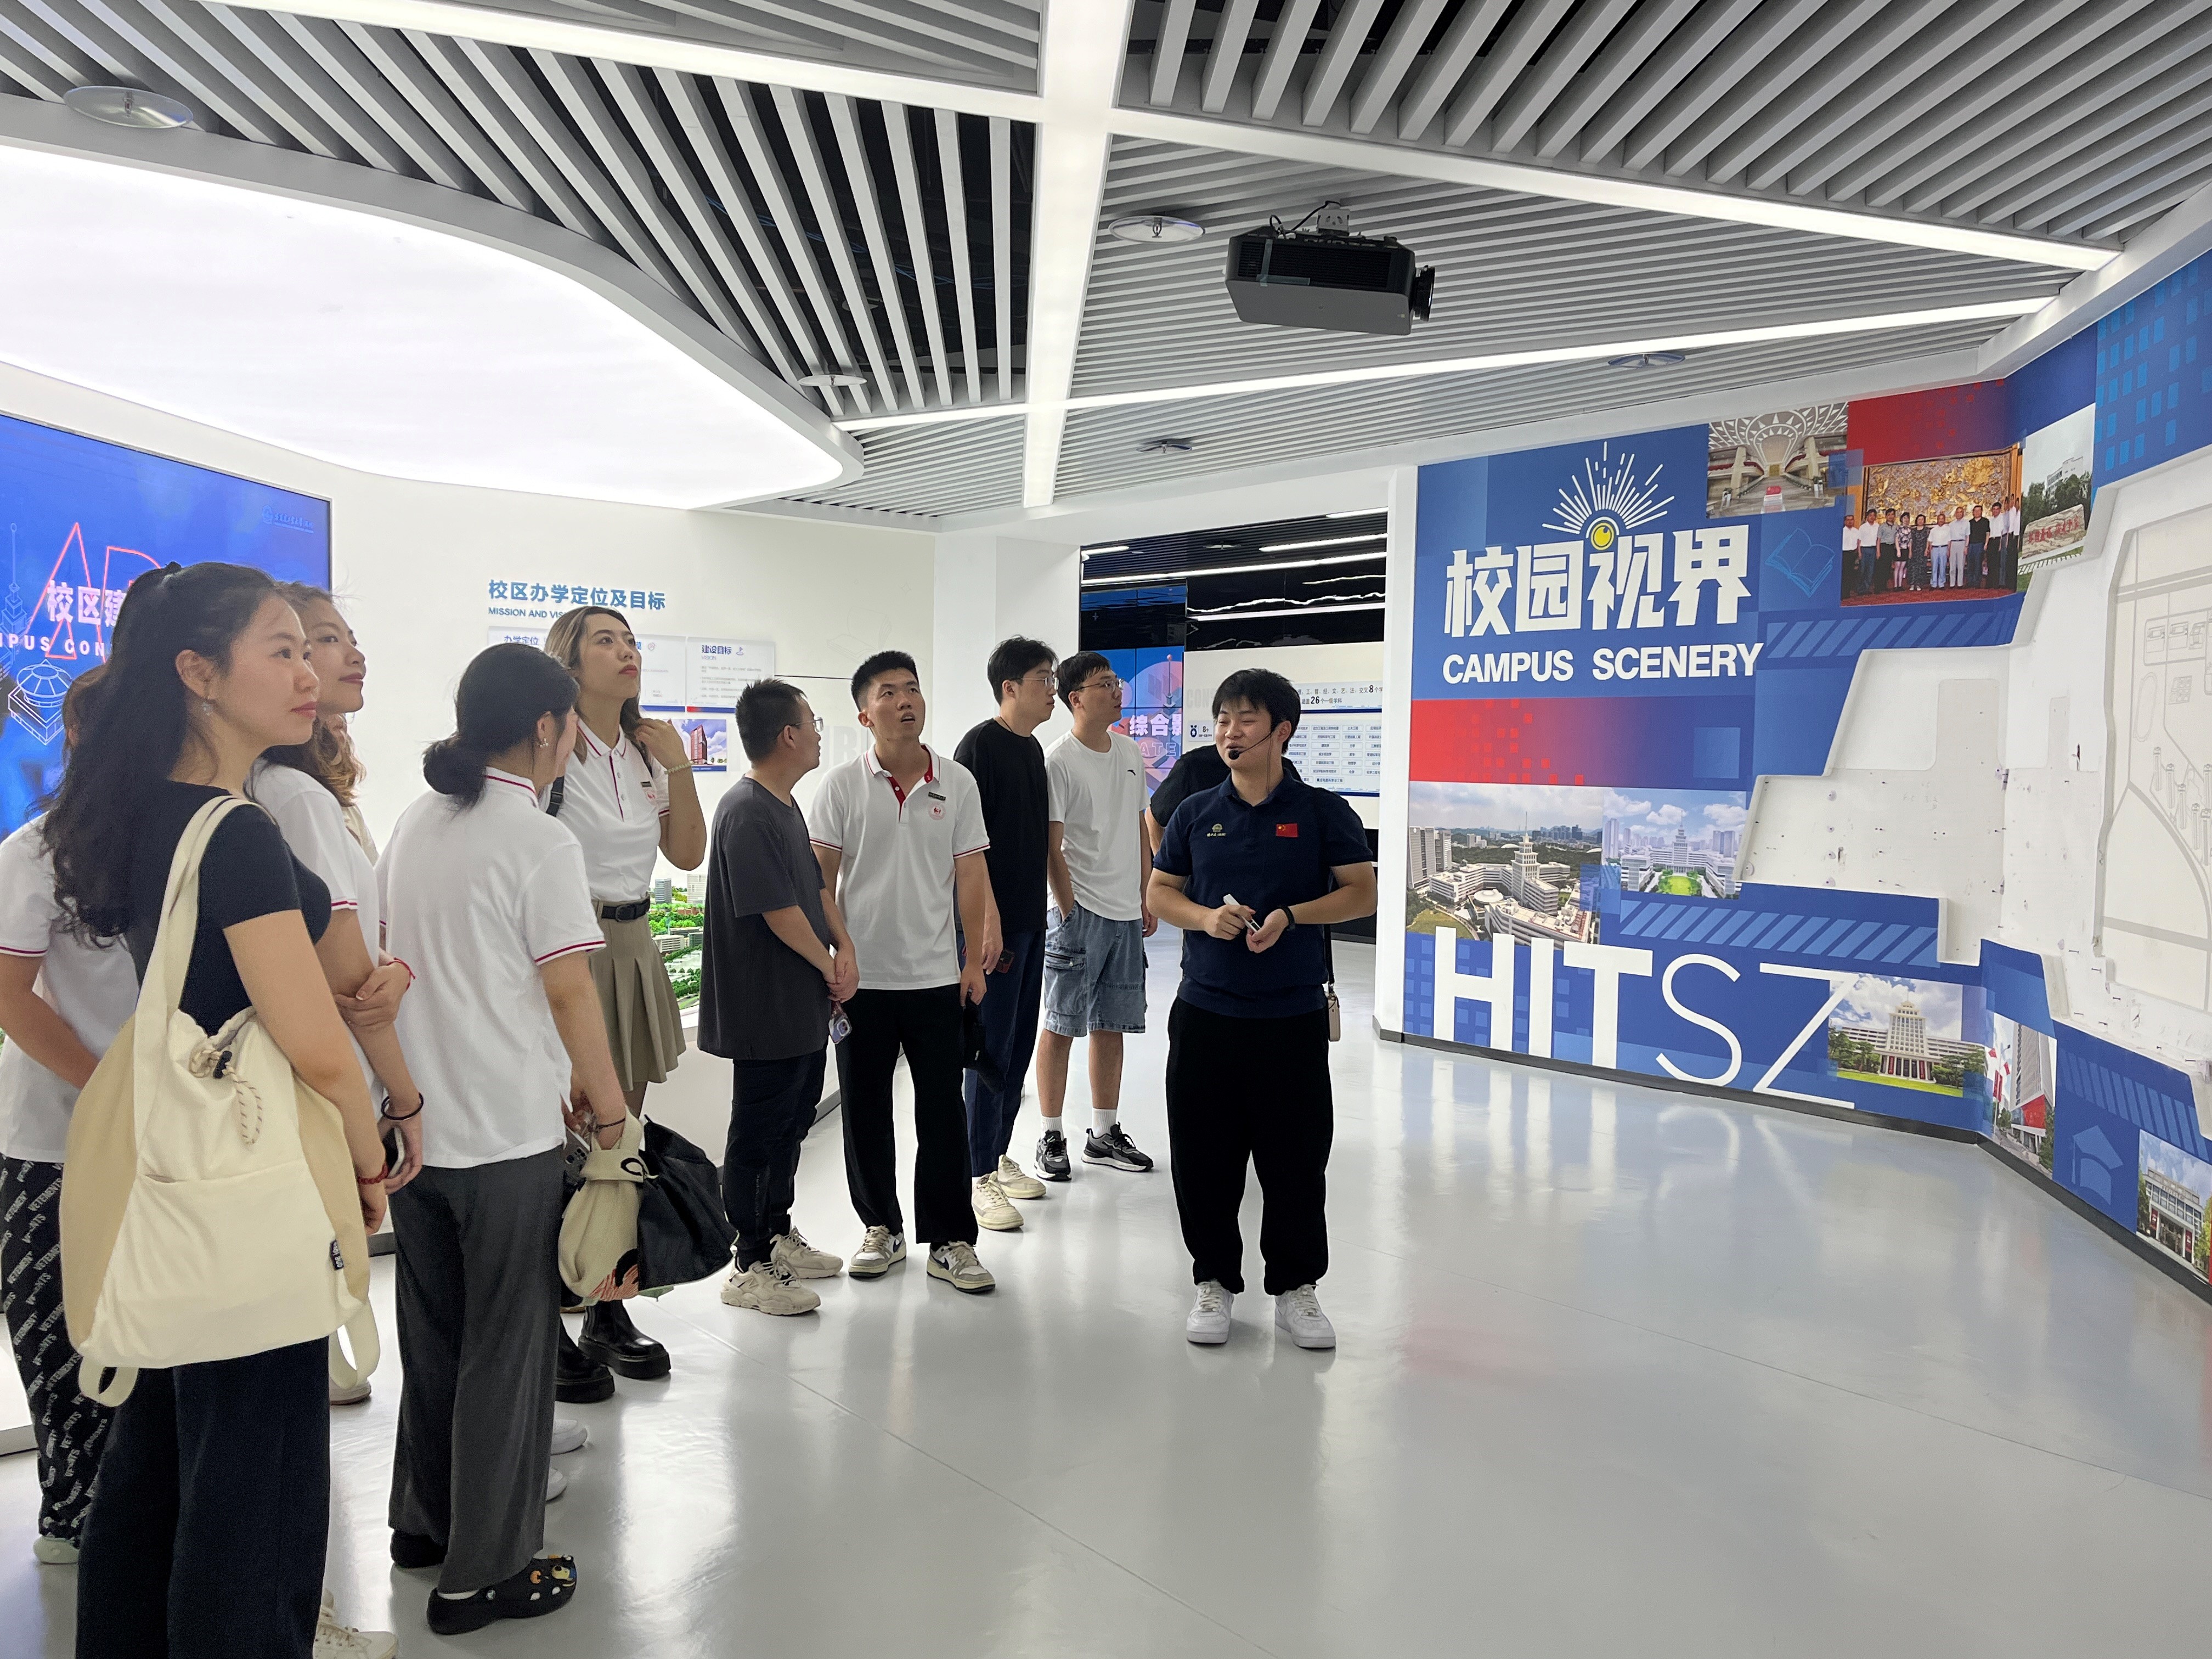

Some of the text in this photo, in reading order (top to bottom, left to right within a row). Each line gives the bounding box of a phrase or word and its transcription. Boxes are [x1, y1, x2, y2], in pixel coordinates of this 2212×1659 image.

[488, 579, 665, 610] 校区办学定位及目标
[1443, 524, 1752, 638] 校园视界
[488, 607, 526, 617] MISSION
[702, 645, 732, 654] 建设目标
[1442, 642, 1764, 684] CAMPUS SCENERY
